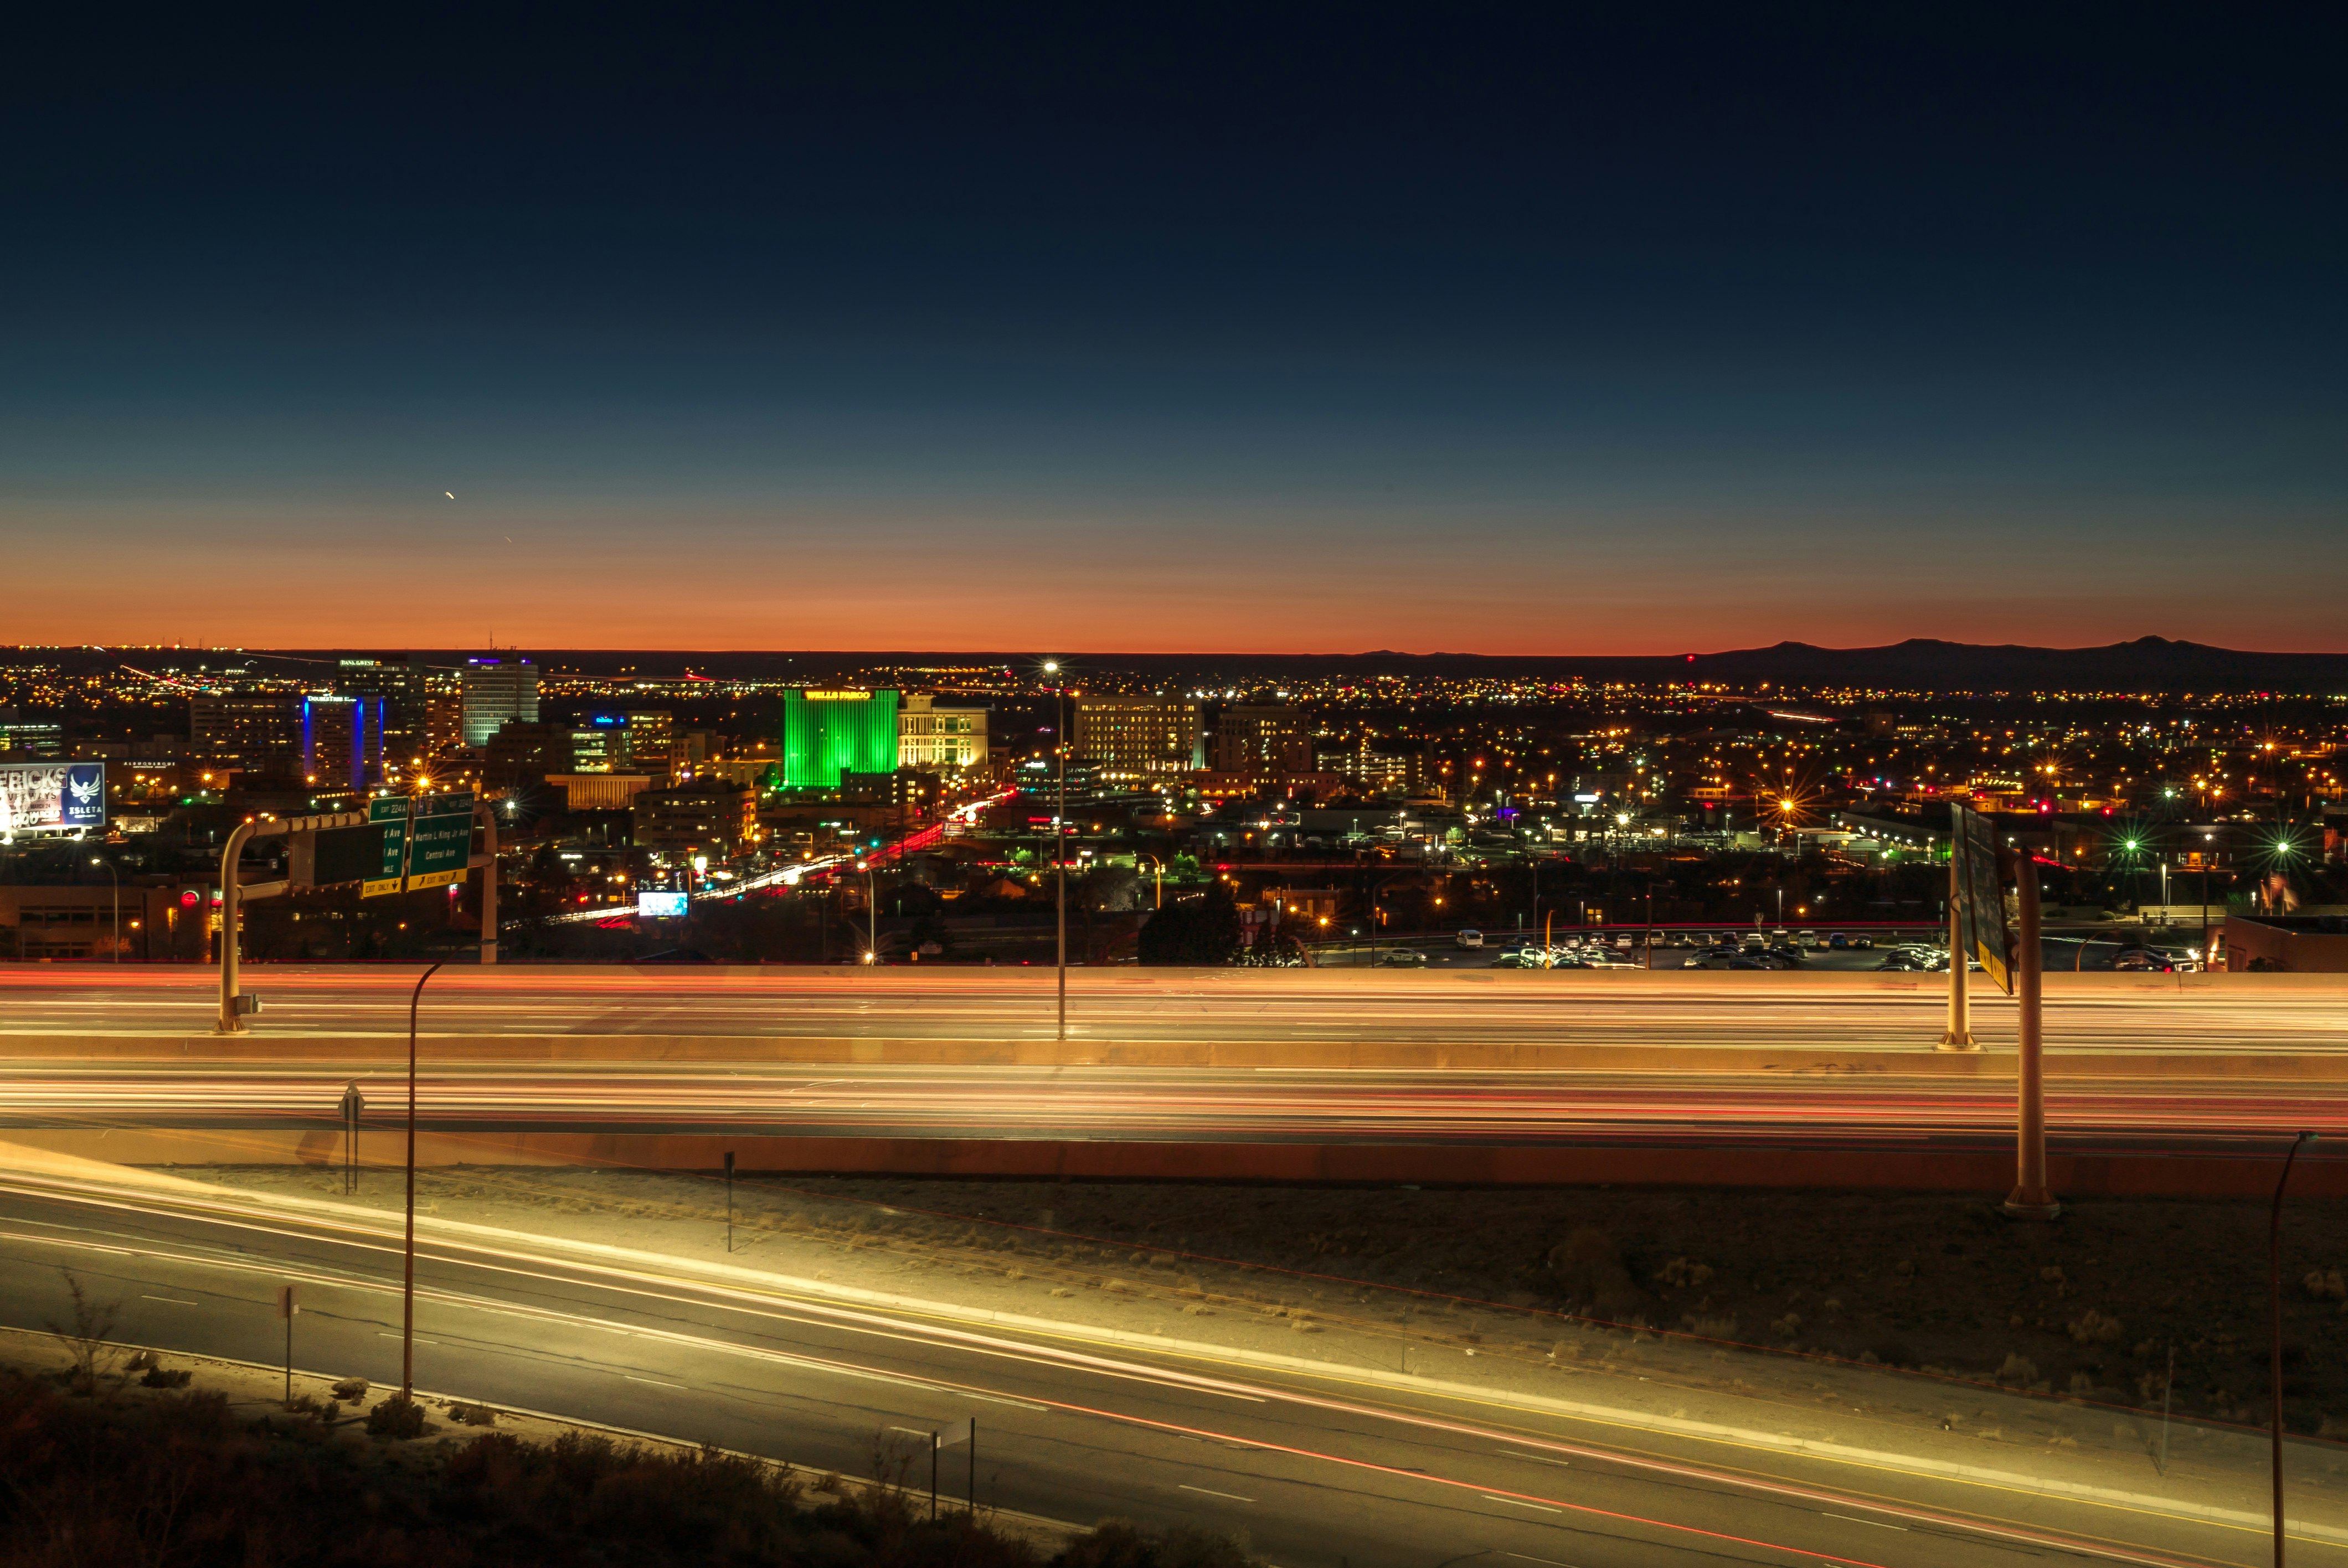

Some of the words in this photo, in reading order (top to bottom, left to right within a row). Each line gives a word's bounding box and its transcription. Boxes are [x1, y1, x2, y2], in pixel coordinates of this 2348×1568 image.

[839, 691, 870, 699] FARGO
[391, 804, 406, 813] 224A
[390, 829, 400, 838] Ave
[415, 833, 432, 841] Martin
[434, 831, 437, 840] L
[439, 831, 450, 840] King
[452, 829, 458, 837] Jr
[387, 848, 398, 857] Ave
[426, 850, 444, 860] Central
[445, 849, 455, 857] Ave
[427, 876, 436, 884] EXIT
[378, 883, 390, 891] ONLY
